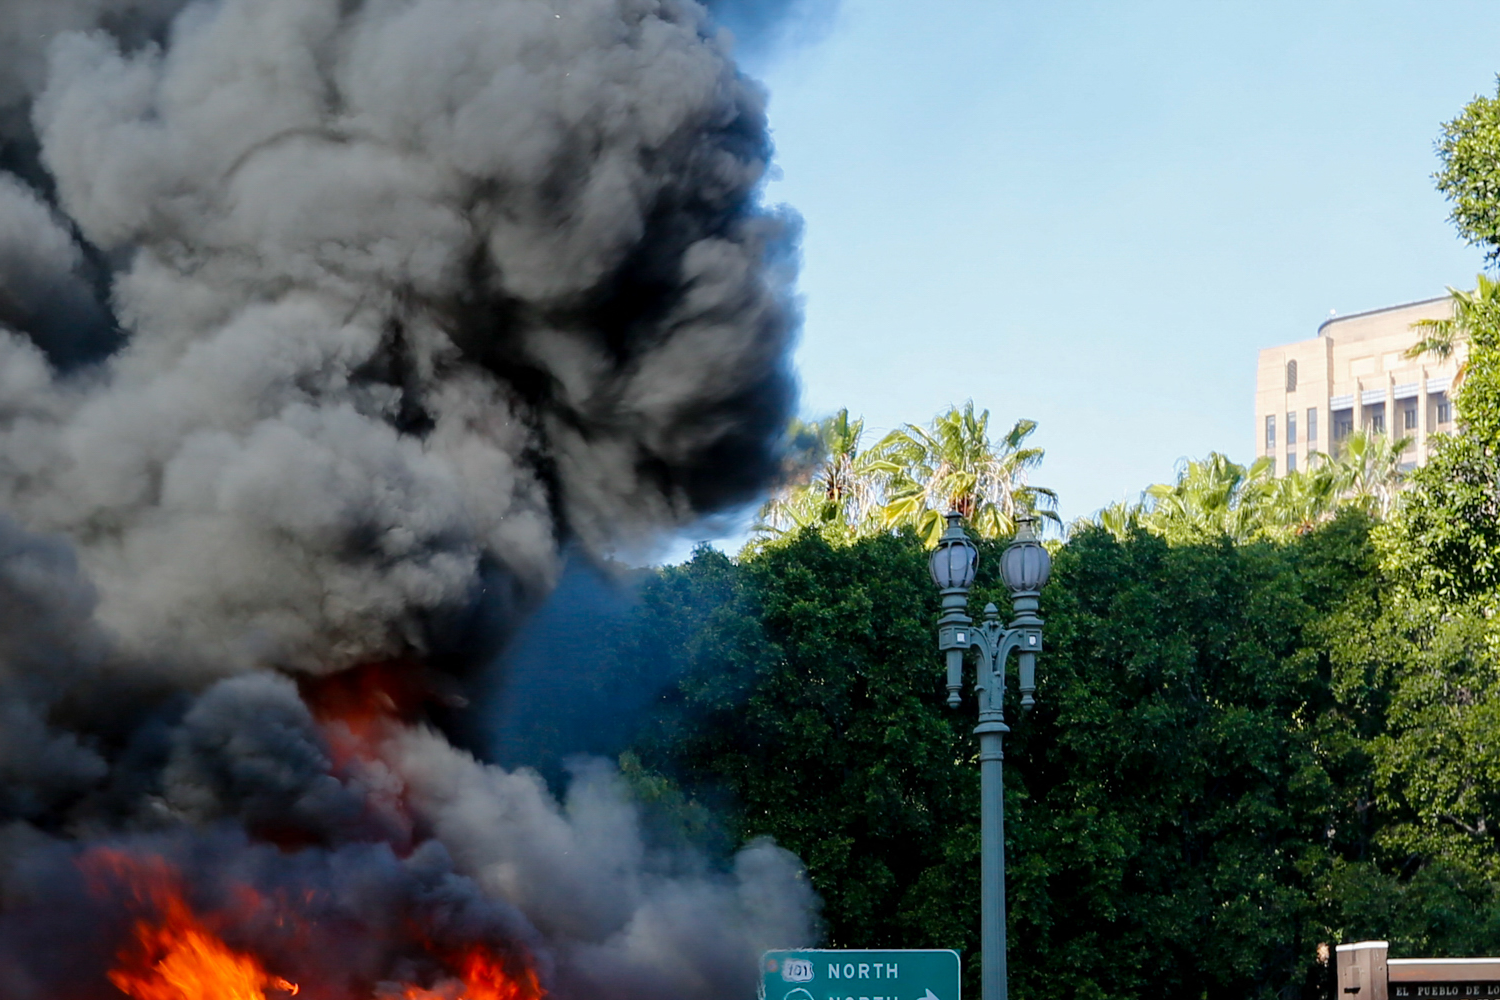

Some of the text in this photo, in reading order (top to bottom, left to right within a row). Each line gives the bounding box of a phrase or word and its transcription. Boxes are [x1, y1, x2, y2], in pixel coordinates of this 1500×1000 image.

[828, 963, 898, 979] NORTH
[1396, 987, 1409, 996] EL
[1417, 986, 1459, 996] PUEBLO
[1465, 986, 1480, 995] DE
